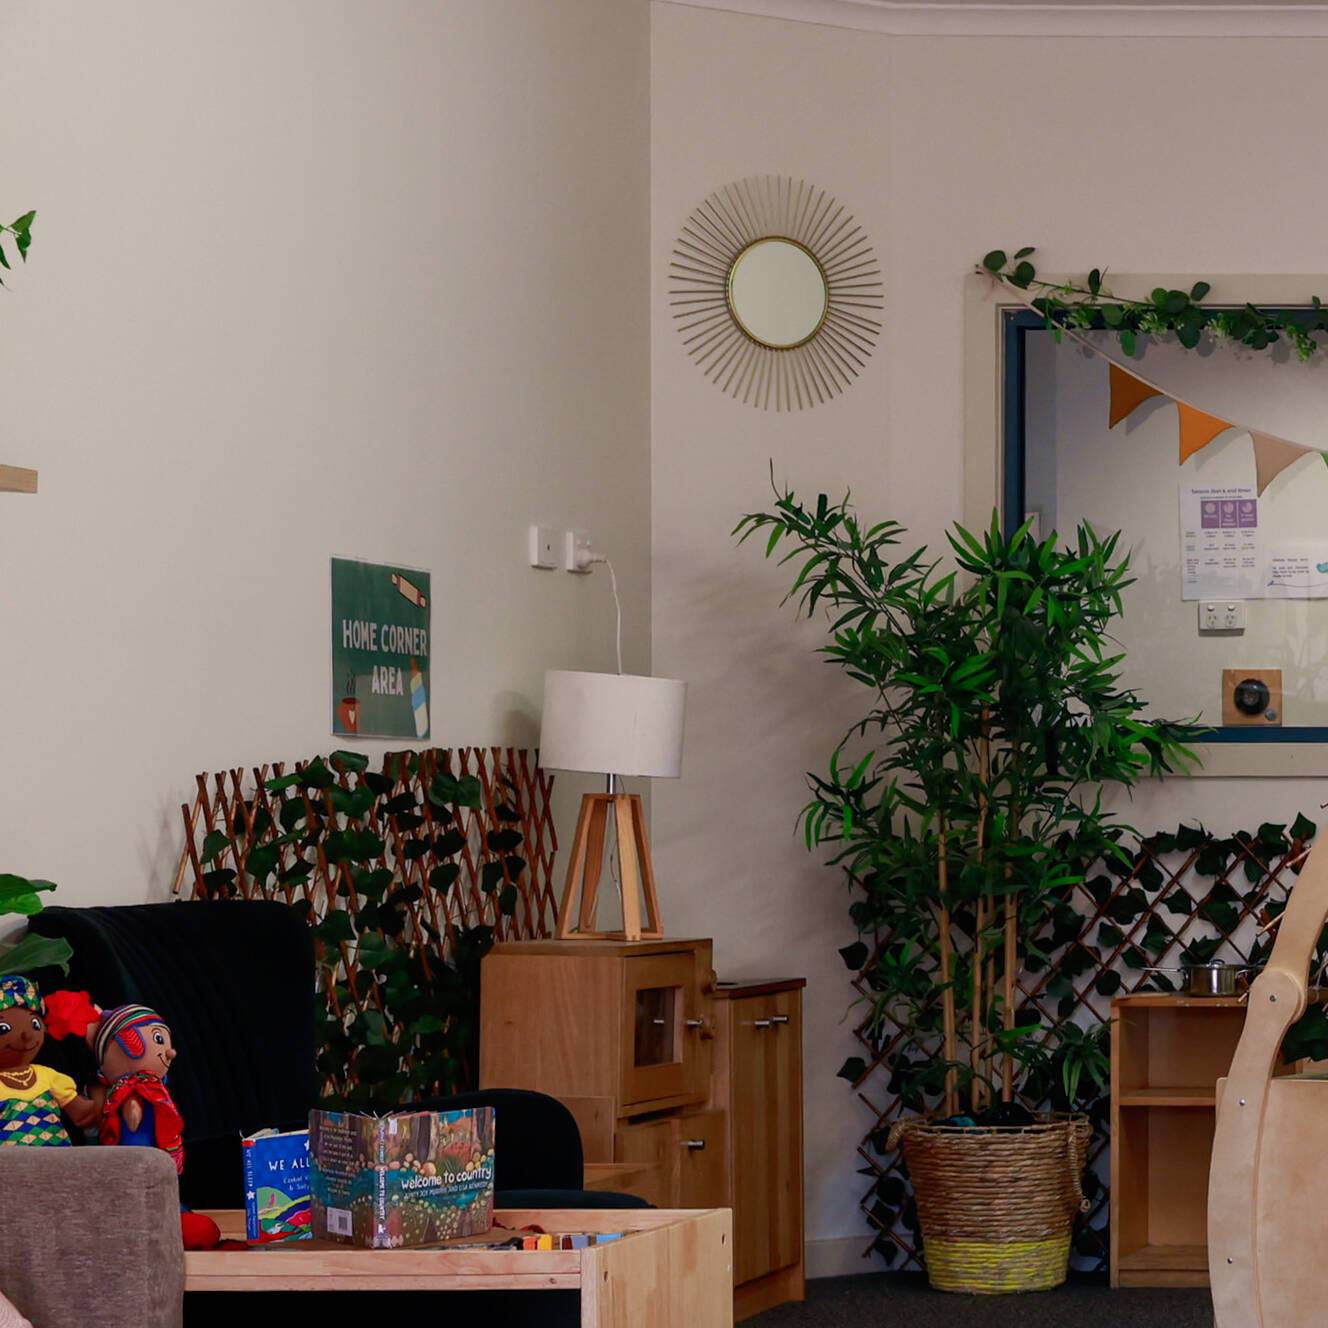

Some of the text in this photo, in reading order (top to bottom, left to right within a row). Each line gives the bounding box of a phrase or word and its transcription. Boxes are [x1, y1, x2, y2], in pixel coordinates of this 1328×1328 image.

[342, 619, 428, 656] HOME CORNER
[371, 665, 404, 696] AREA
[268, 1158, 310, 1171] WE ALL
